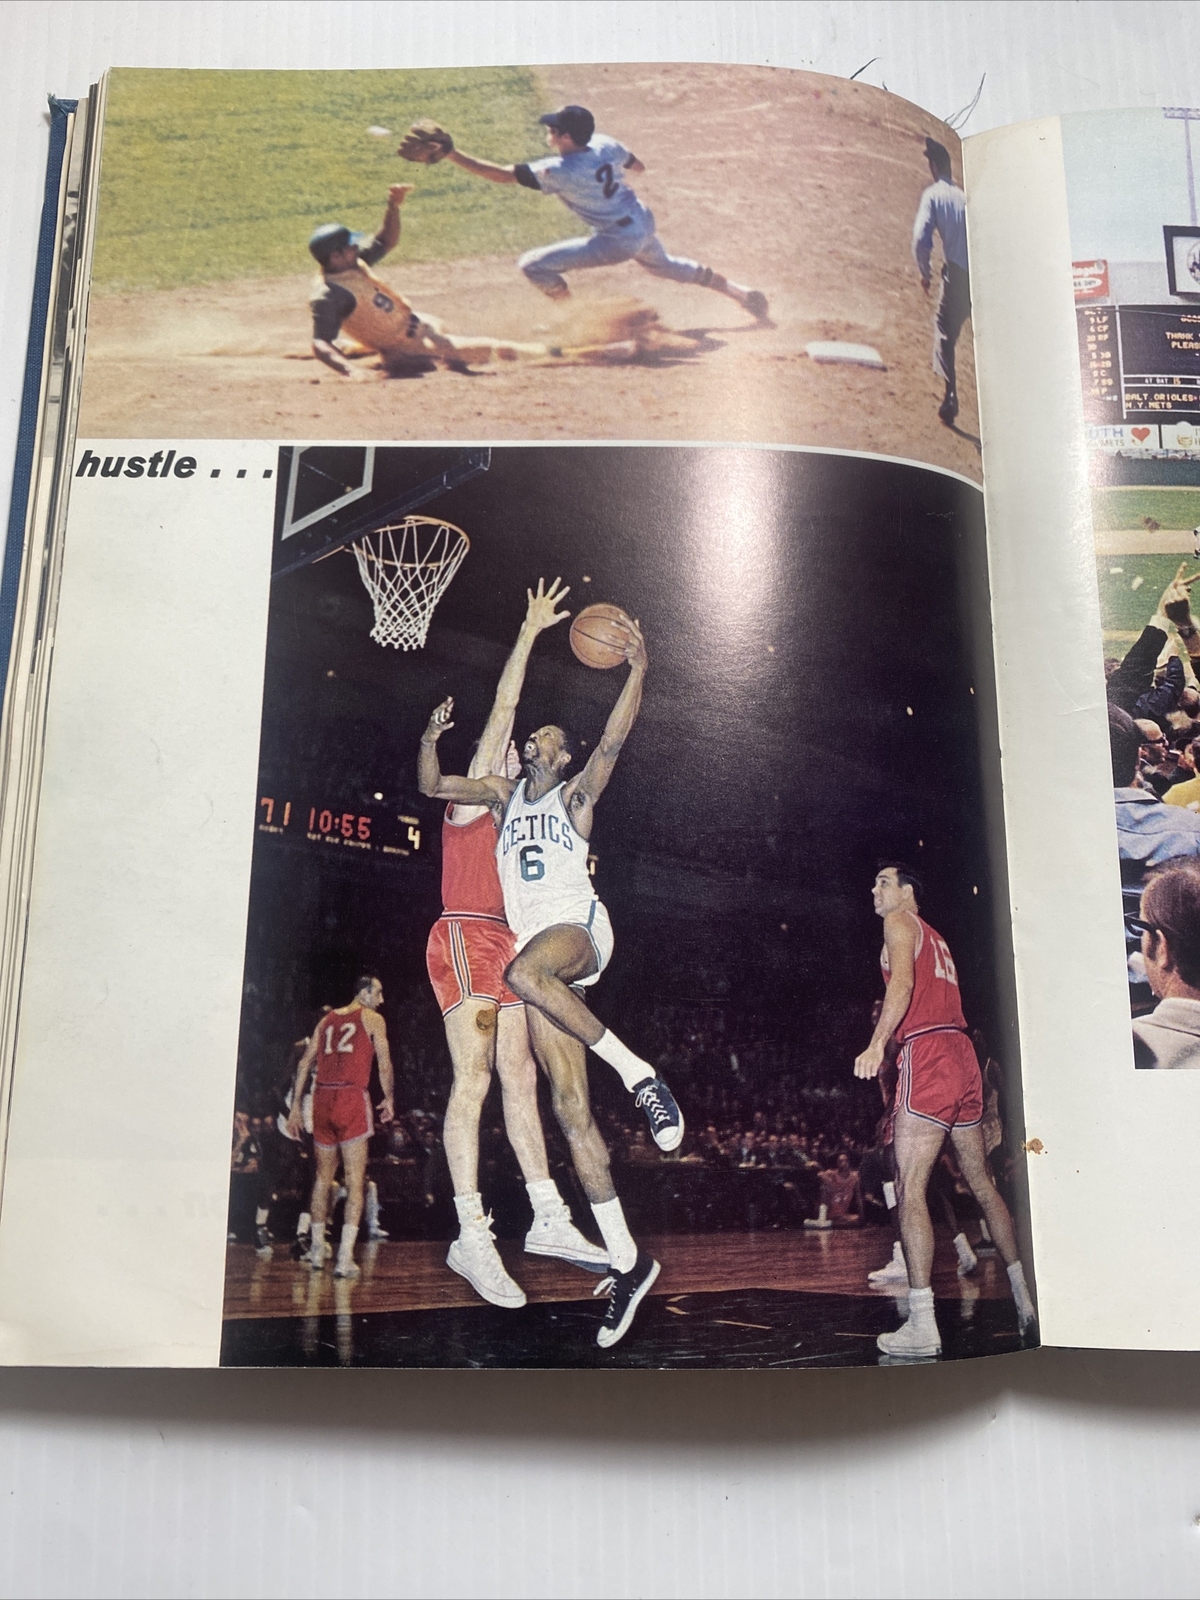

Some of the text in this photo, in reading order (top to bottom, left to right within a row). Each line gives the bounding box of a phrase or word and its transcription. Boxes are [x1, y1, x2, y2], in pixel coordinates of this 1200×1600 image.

[595, 163, 620, 199] 2
[1165, 332, 1194, 340] THANK
[75, 449, 197, 478] hustle
[308, 807, 372, 840] 10:55
[408, 826, 421, 850] 4
[519, 844, 546, 882] 6
[324, 1022, 356, 1055] 12
